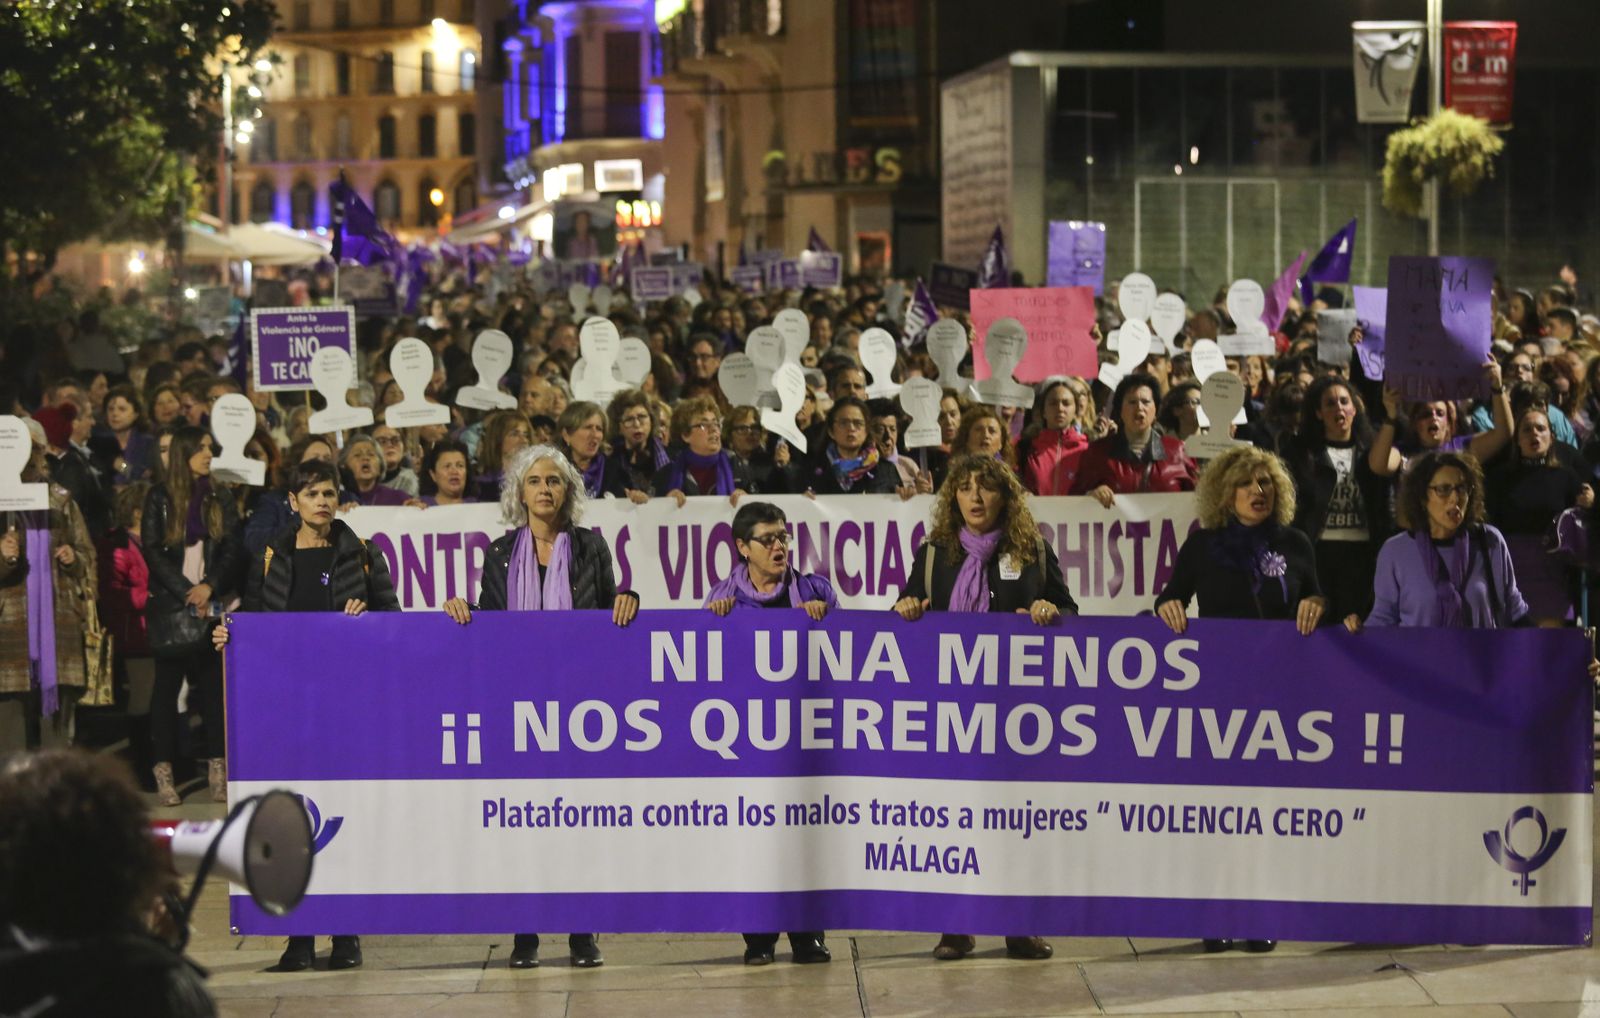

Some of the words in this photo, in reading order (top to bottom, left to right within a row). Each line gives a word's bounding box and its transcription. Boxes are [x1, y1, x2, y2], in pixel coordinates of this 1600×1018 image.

[261, 326, 301, 335] Violencia
[302, 325, 313, 334] de
[314, 324, 346, 333] Género
[287, 314, 307, 323] Ante
[309, 314, 317, 322] la
[271, 362, 287, 380] TE
[650, 630, 723, 682] NI
[754, 630, 911, 683] UNA
[938, 632, 1201, 691] MENOS
[513, 699, 663, 752] NOS
[690, 698, 1097, 760] QUEREMOS
[1123, 705, 1334, 763] VIVAS
[1363, 712, 1405, 765] !!
[482, 797, 633, 828] Plataforma
[642, 799, 728, 827] contra
[738, 796, 776, 827] los
[785, 794, 861, 826] malos
[870, 798, 950, 828] tratos
[957, 806, 974, 829] a
[982, 800, 1088, 840] mujeres
[1118, 803, 1264, 835] VIOLENCIA
[1273, 808, 1344, 837] CERO
[865, 836, 980, 875] MÁLAGA
